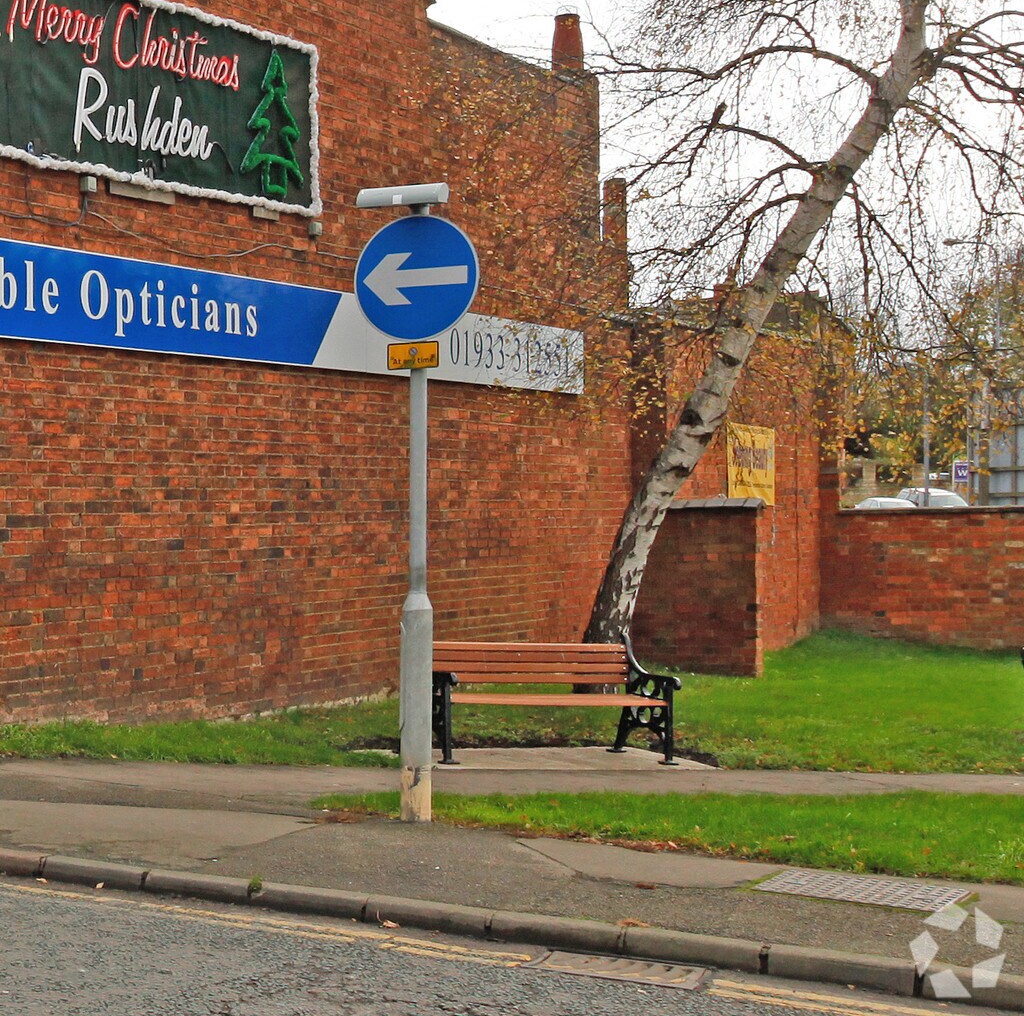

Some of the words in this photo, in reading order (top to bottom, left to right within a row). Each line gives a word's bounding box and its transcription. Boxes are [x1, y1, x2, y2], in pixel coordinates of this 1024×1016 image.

[112, 2, 241, 92] Christmas
[73, 67, 215, 161] Rushden
[79, 269, 260, 338] Opticians
